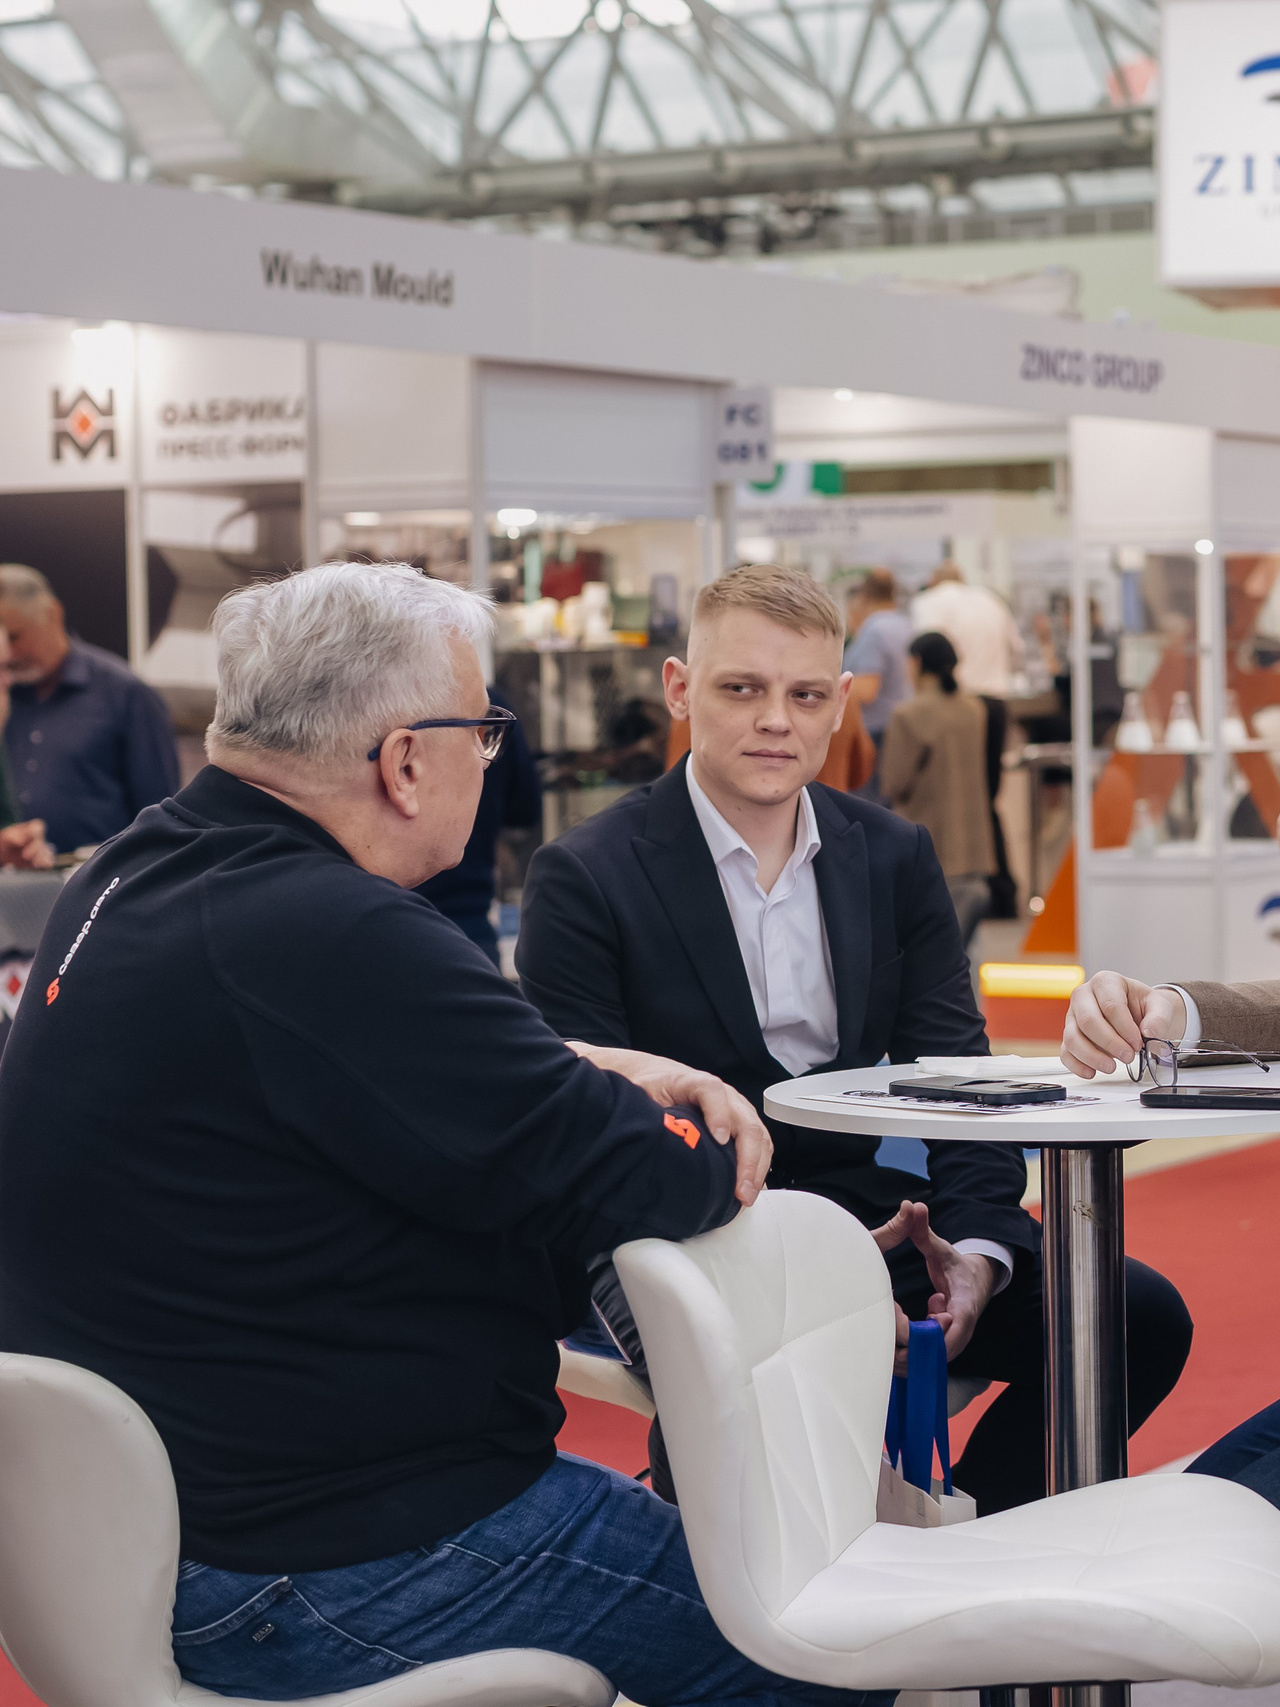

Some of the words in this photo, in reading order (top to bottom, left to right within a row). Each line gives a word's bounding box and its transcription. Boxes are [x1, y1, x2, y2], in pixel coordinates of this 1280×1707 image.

[259, 248, 364, 297] Wuhan
[371, 261, 455, 307] Mould
[1020, 343, 1086, 386] ZINCO
[1091, 352, 1165, 394] GROUP
[725, 404, 760, 427] FC
[58, 920, 92, 976] север
[90, 877, 120, 920] авто
